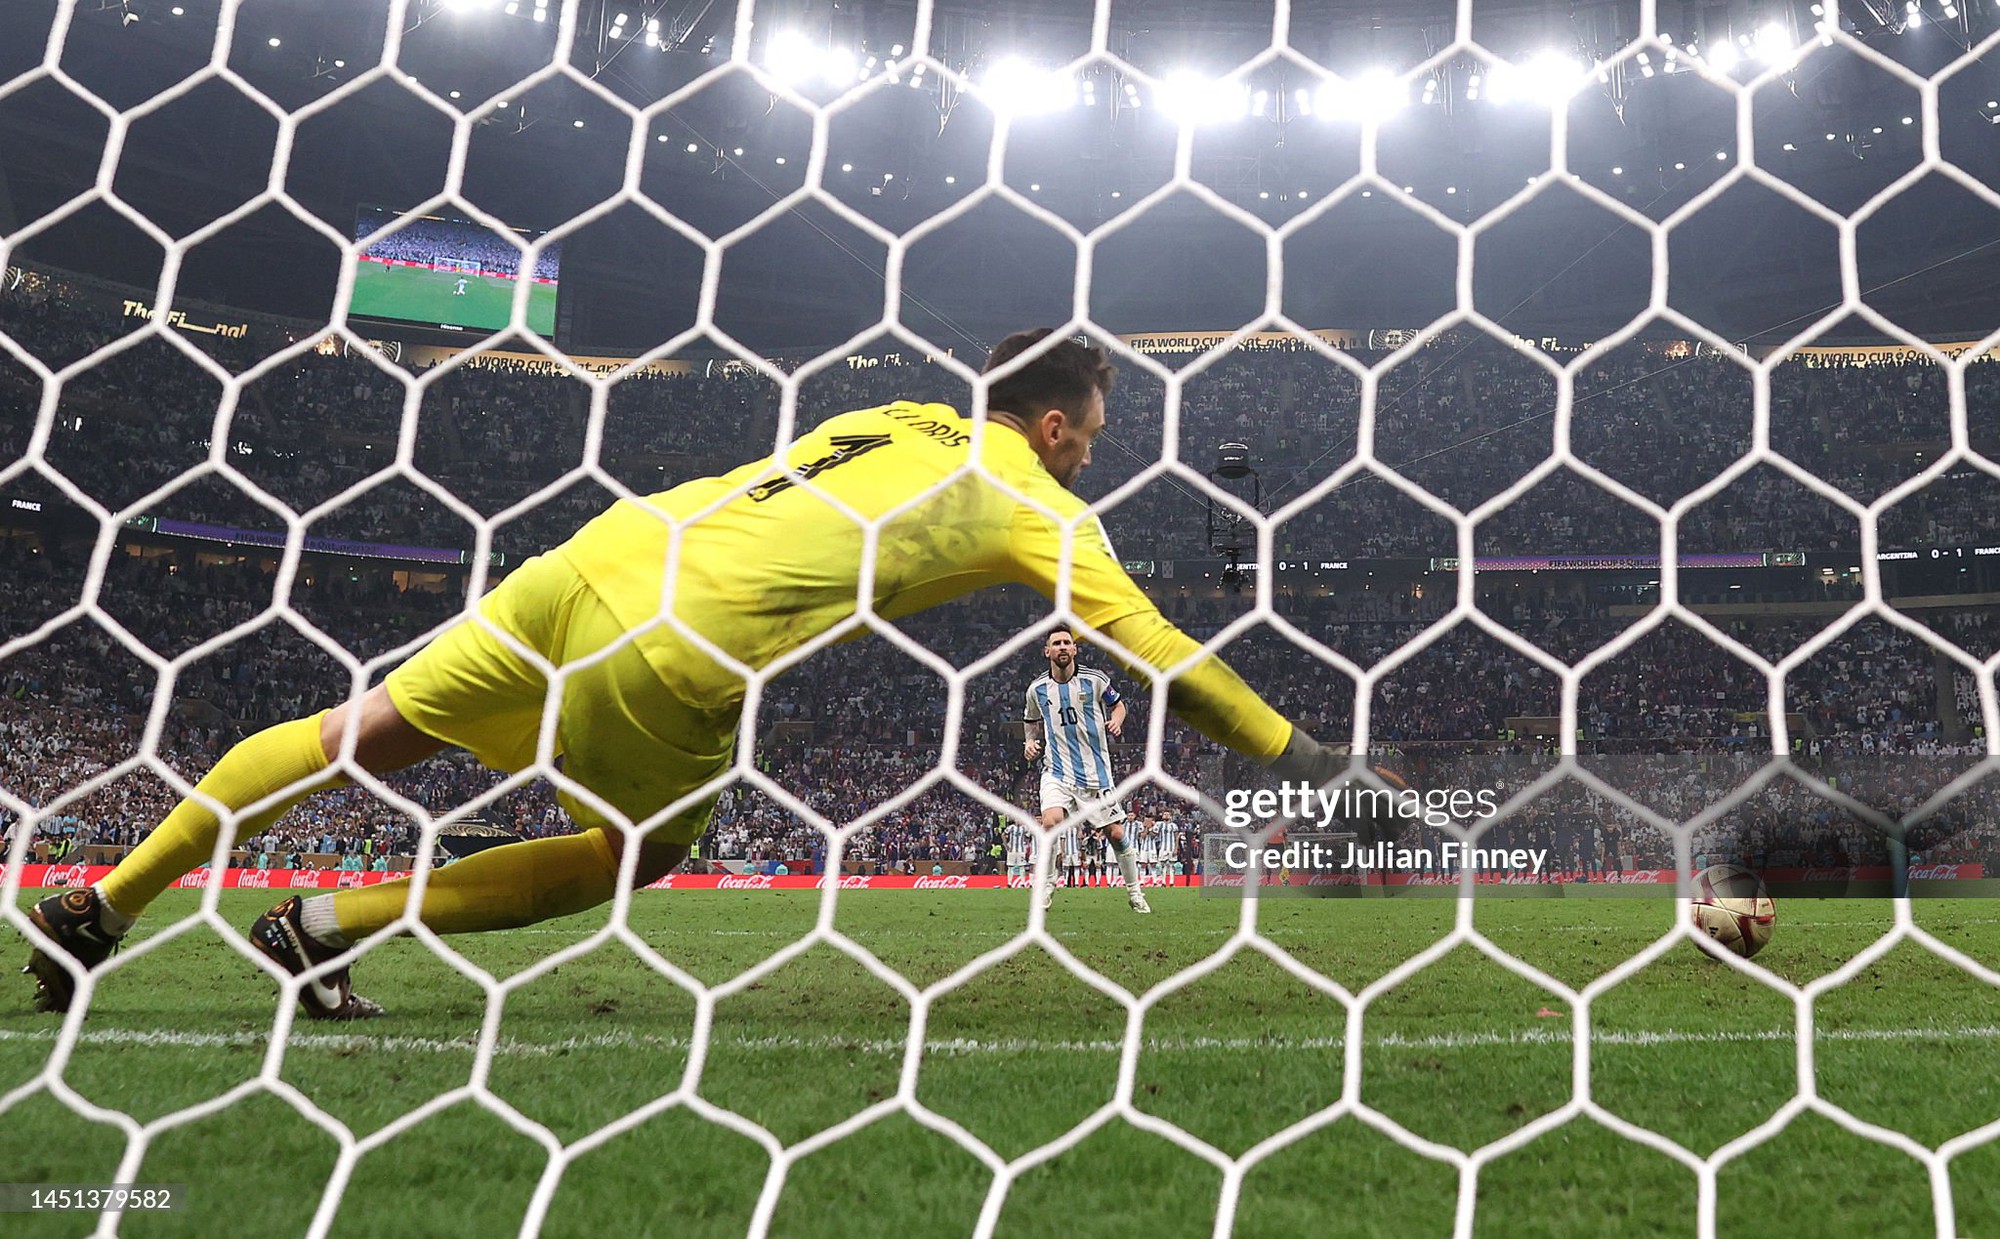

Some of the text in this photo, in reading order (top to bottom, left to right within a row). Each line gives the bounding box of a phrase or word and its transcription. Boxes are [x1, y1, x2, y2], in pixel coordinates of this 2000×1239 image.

[1131, 339, 1155, 349] FIFA
[1157, 337, 1200, 348] WORLD
[479, 356, 525, 369] WORLD
[527, 359, 553, 371] CUP
[1821, 352, 1867, 363] WORLD
[1868, 351, 1894, 362] CUP
[12, 499, 41, 512] FRANCE
[1876, 551, 1918, 560] ARGENTINA
[1931, 549, 1940, 559] 0
[1956, 548, 1962, 558] 1
[1974, 547, 2000, 556] FRANC
[1279, 562, 1287, 571] 0
[1303, 562, 1308, 571] 1
[1058, 706, 1078, 727] 10
[238, 868, 271, 888] Coca-Cola
[290, 869, 321, 888] Coca-Cola
[716, 874, 775, 889] Coca-Cola
[913, 875, 969, 889] Coca-Cola
